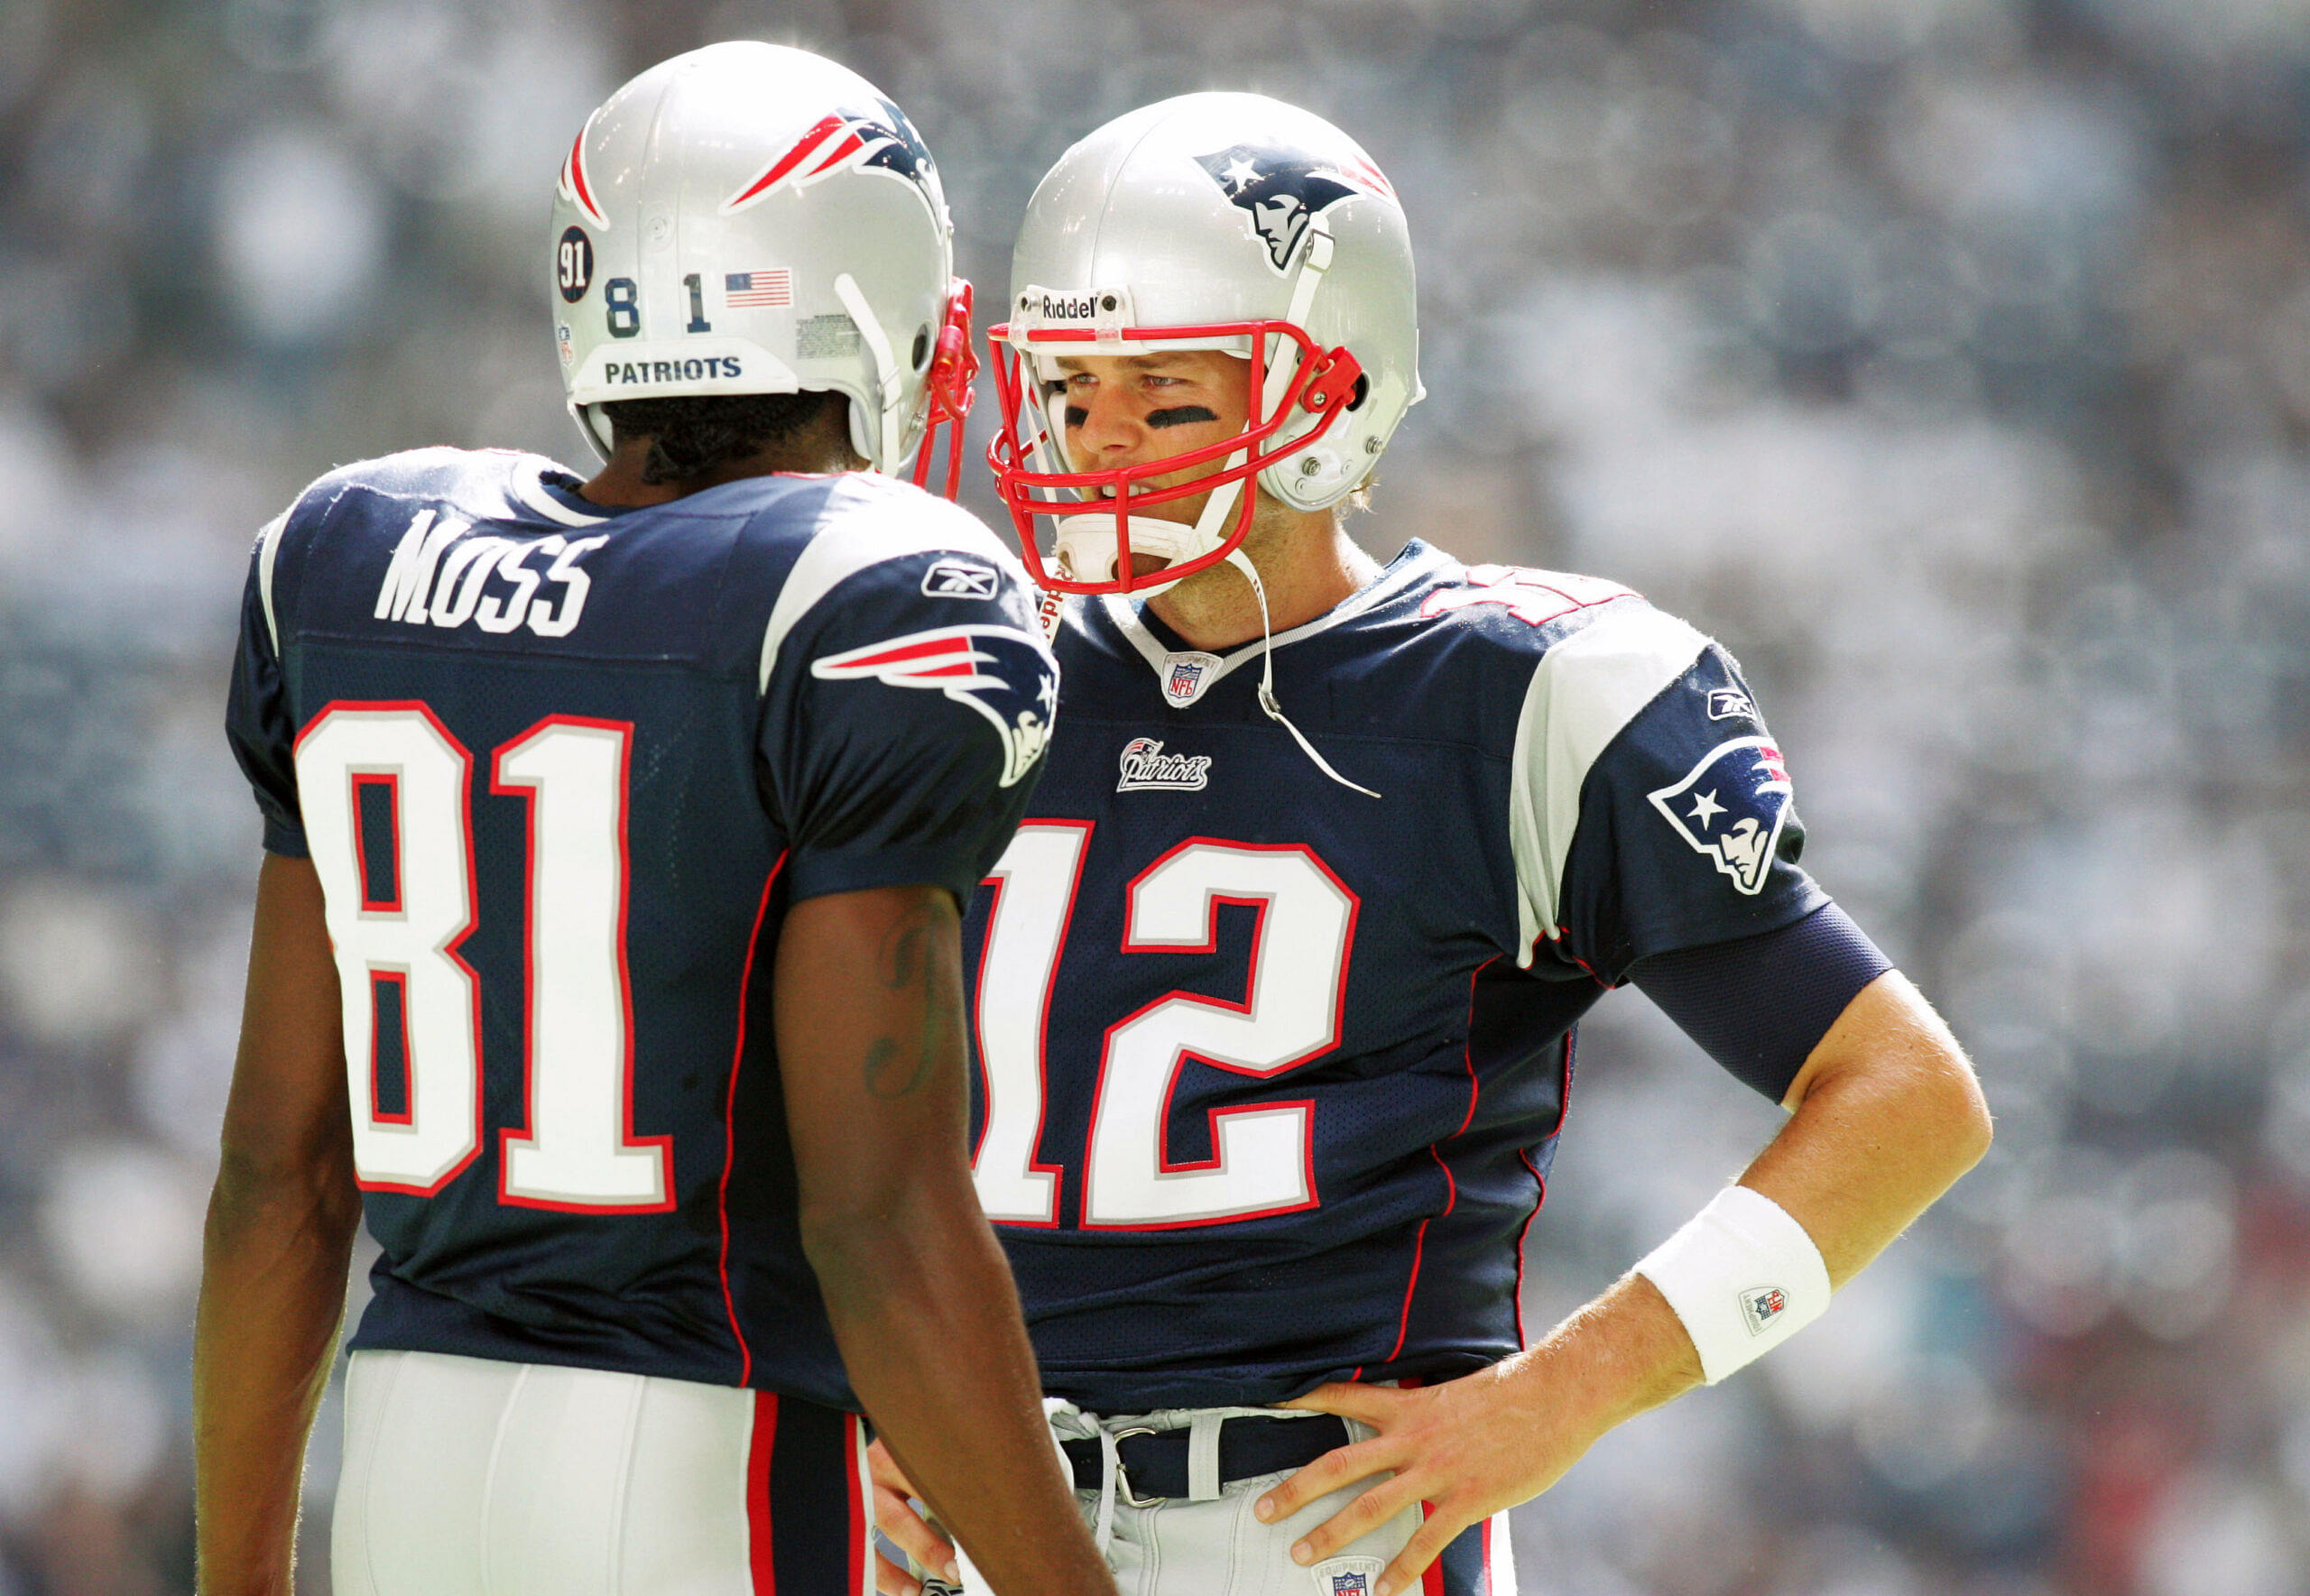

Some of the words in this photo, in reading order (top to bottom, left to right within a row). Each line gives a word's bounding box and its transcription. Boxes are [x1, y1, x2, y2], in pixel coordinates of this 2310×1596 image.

[560, 242, 587, 288] 91
[605, 356, 743, 384] PATRIOTS
[374, 509, 611, 638] MOSS
[1169, 678, 1194, 697] NFL
[1121, 752, 1213, 783] Patriots
[292, 699, 678, 1215] 81
[971, 818, 1361, 1232] 12
